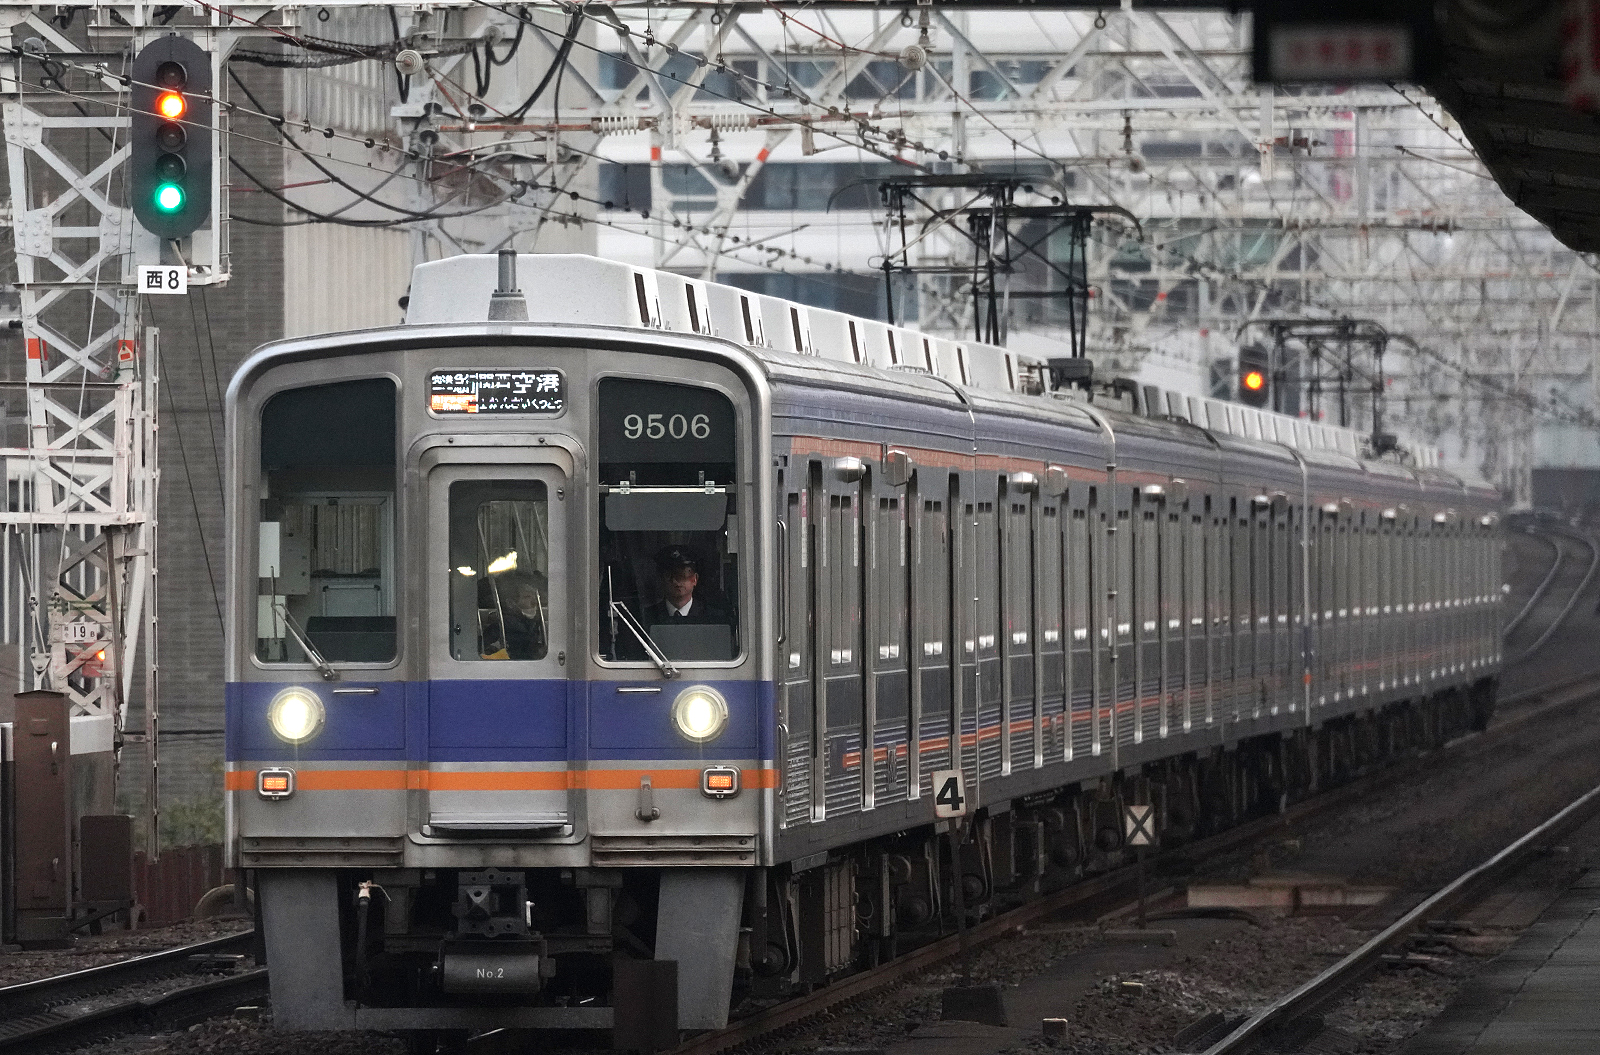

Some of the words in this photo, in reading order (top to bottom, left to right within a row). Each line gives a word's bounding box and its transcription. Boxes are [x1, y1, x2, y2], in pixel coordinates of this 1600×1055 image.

[146, 270, 180, 290] 西8
[623, 413, 710, 439] 9506
[73, 625, 86, 638] 19
[936, 776, 964, 811] 4
[476, 967, 504, 979] No.2
